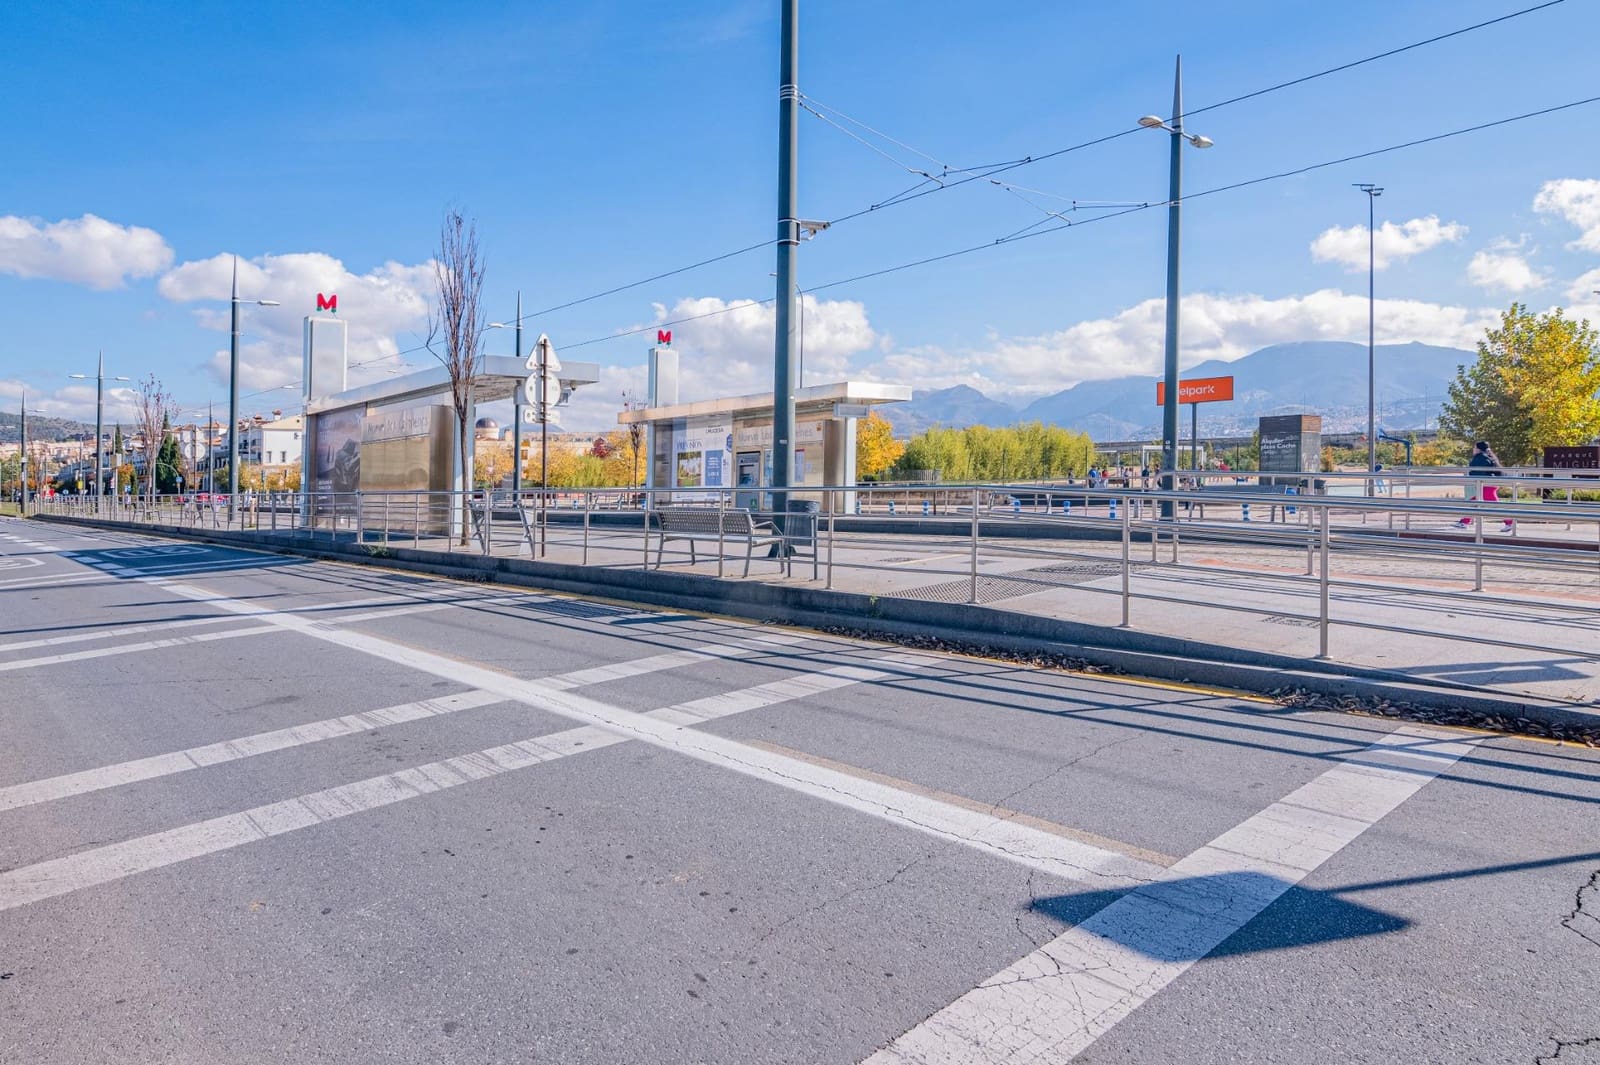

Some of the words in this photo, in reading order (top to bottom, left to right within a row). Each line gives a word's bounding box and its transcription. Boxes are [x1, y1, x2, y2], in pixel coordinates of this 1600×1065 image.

[316, 292, 337, 314] M
[657, 330, 672, 345] M
[1179, 384, 1215, 397] elpark
[1552, 459, 1600, 468] MIGUE
